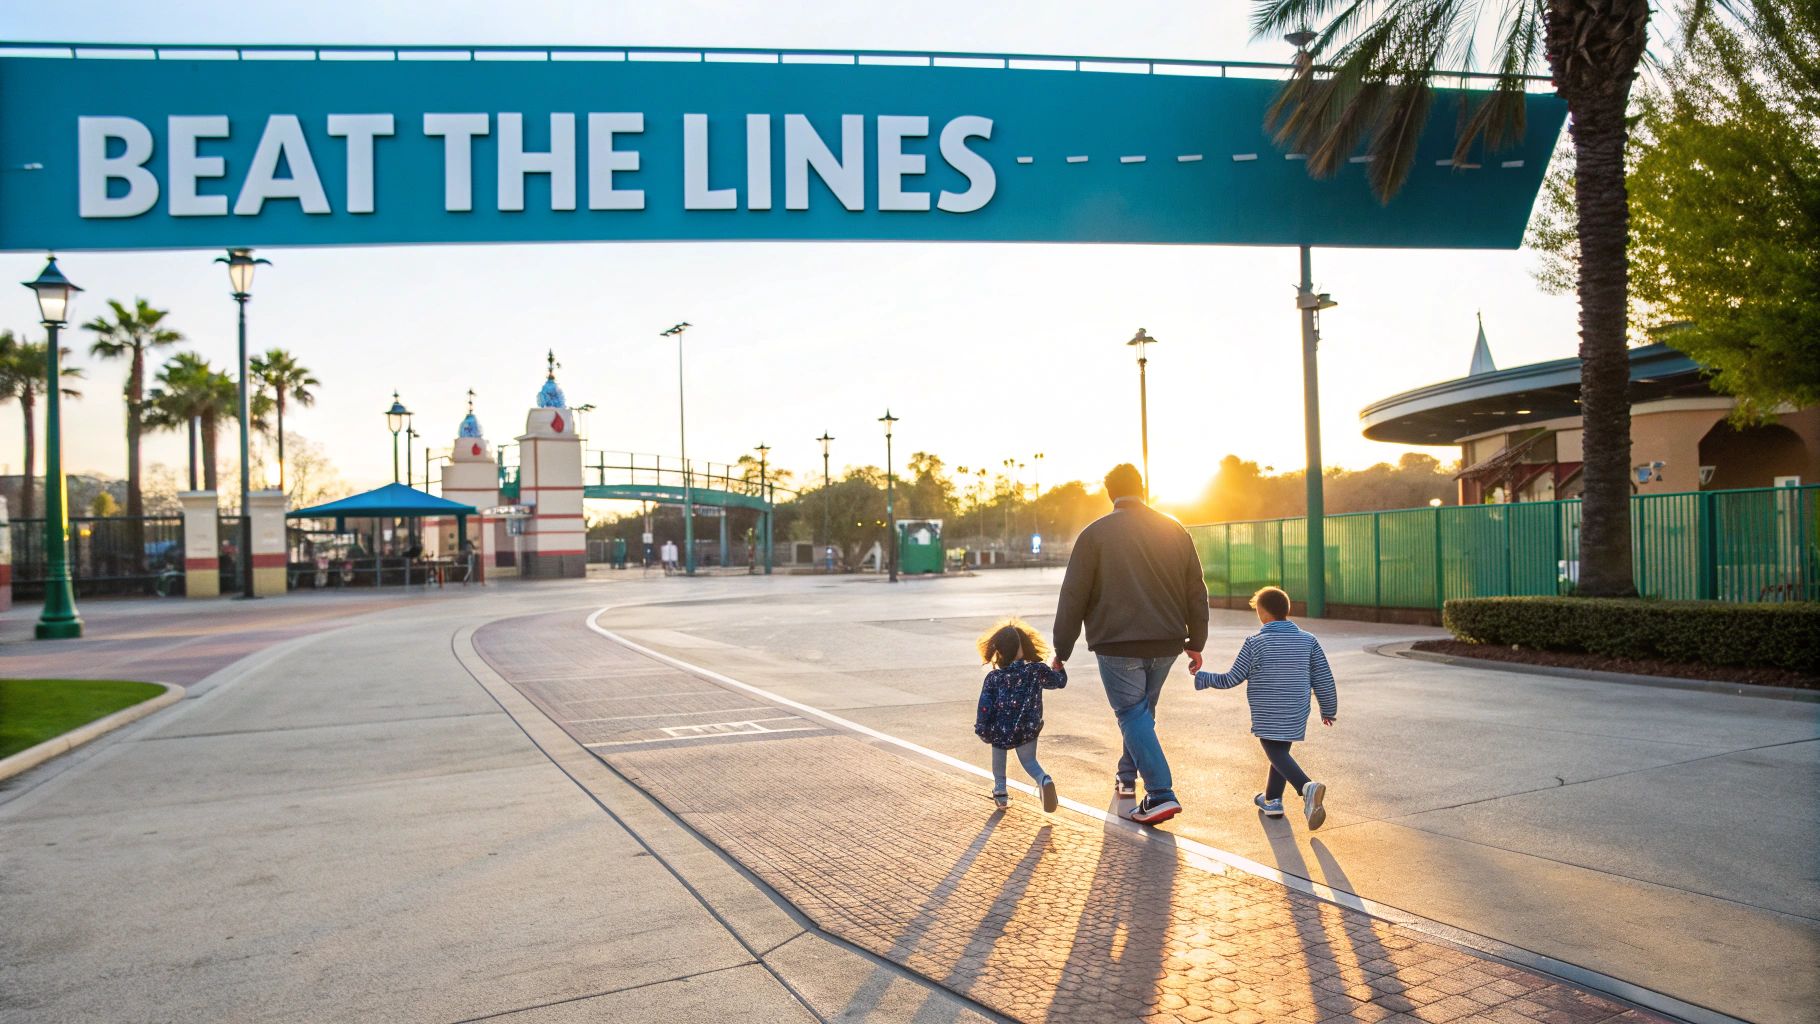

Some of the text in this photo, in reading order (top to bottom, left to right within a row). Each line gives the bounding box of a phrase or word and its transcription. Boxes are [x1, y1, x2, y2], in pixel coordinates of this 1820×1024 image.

[79, 113, 995, 216] BEAT THE LINES
